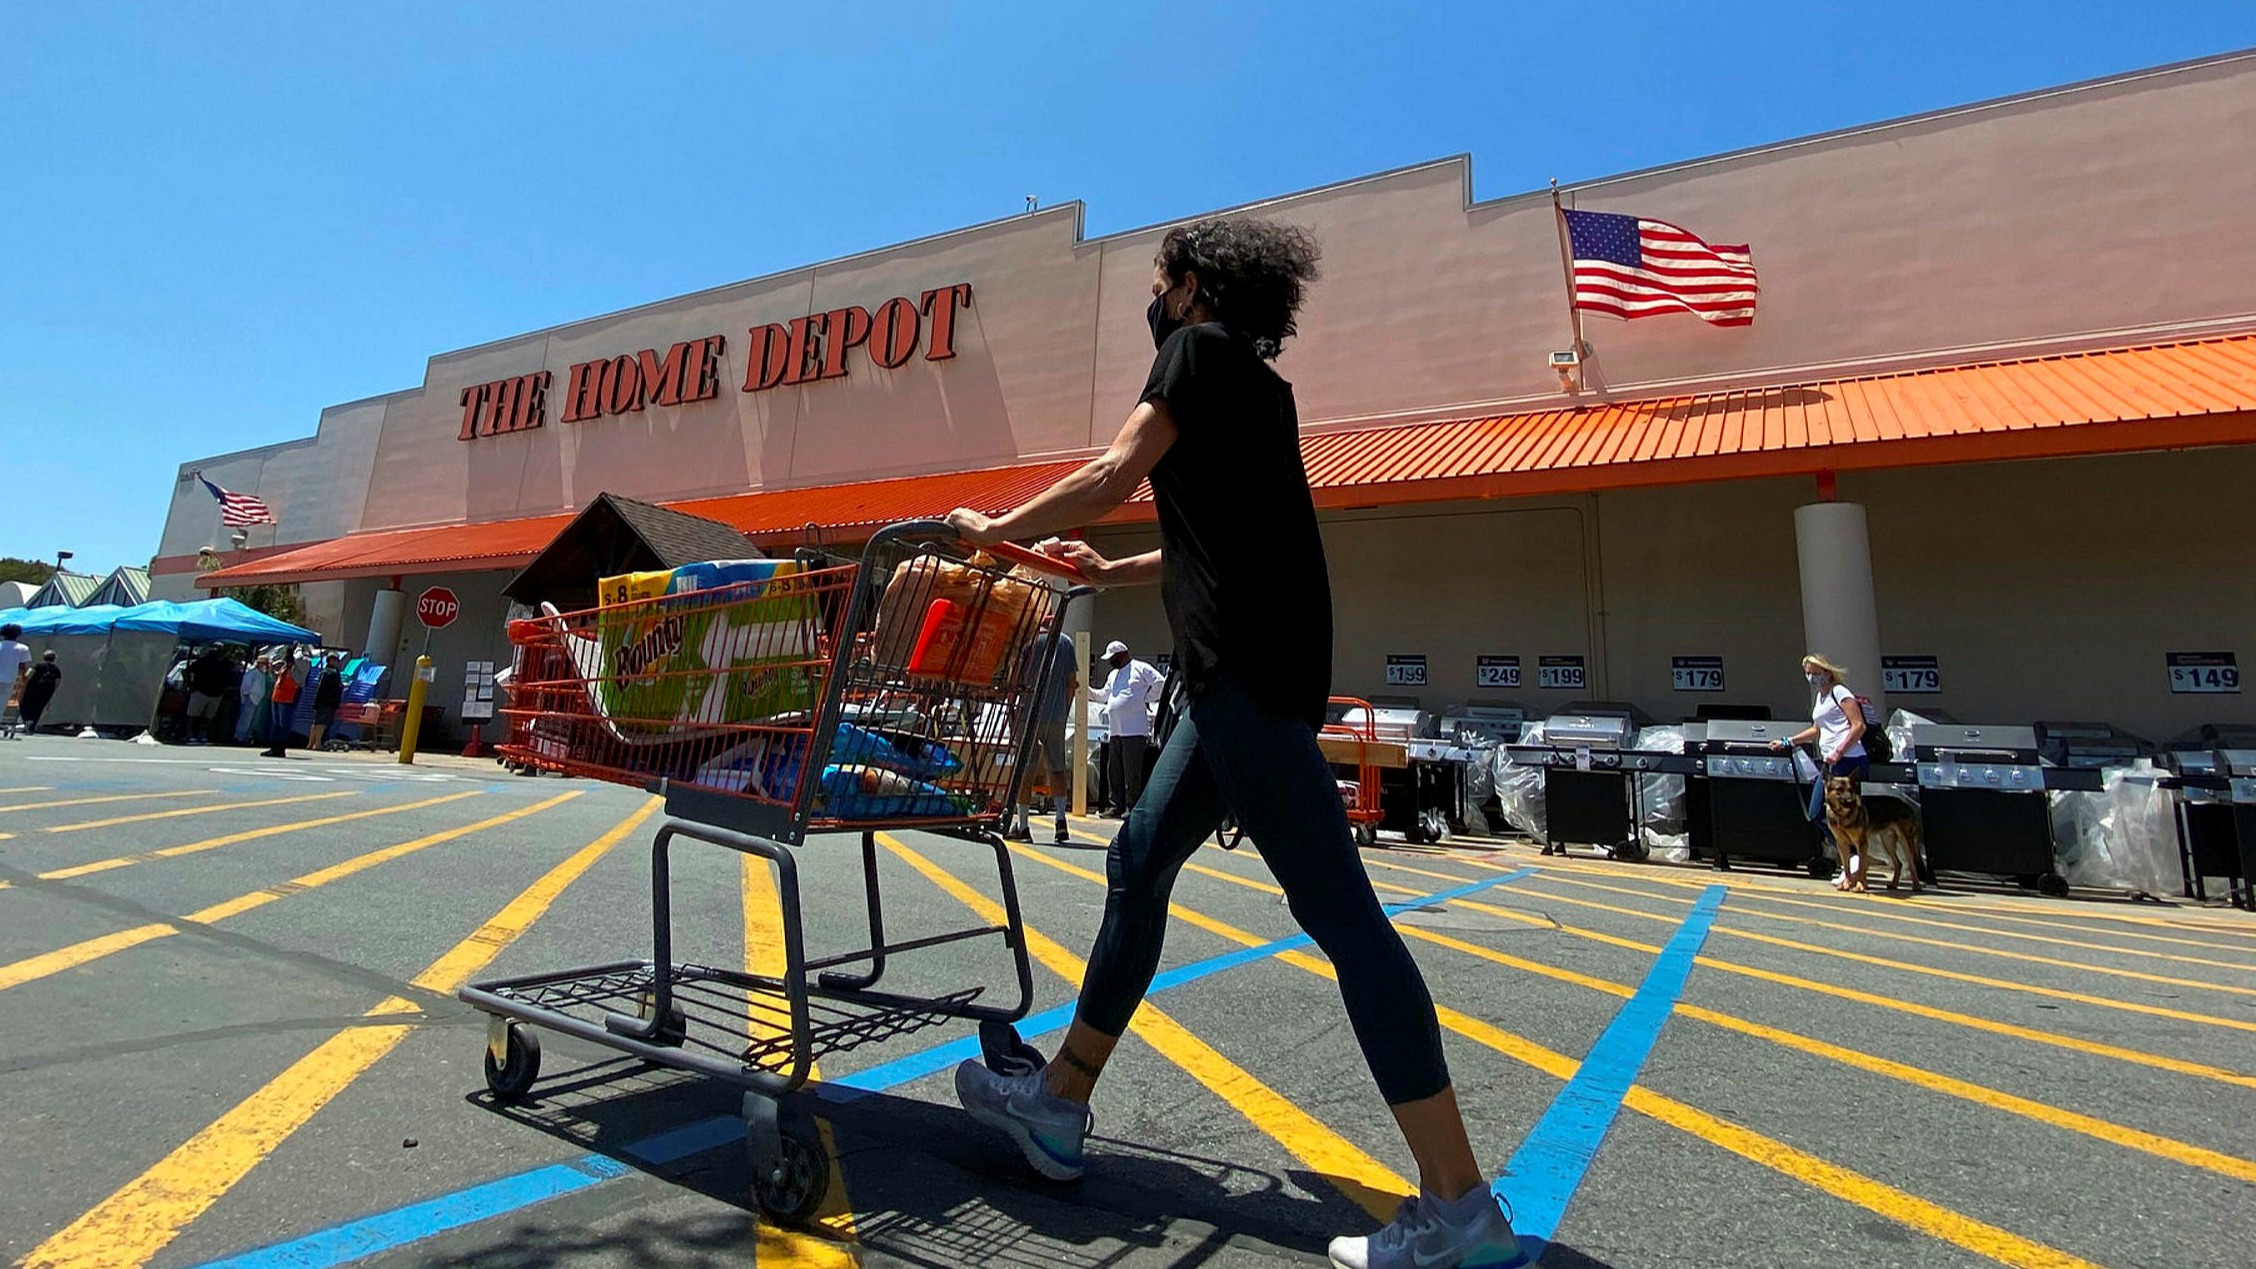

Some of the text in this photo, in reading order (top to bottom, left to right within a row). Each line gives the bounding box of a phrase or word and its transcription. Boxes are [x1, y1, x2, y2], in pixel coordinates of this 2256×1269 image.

[457, 283, 972, 441] THE HOME DEPOT
[419, 598, 457, 617] STOP
[614, 613, 686, 693] Bounty
